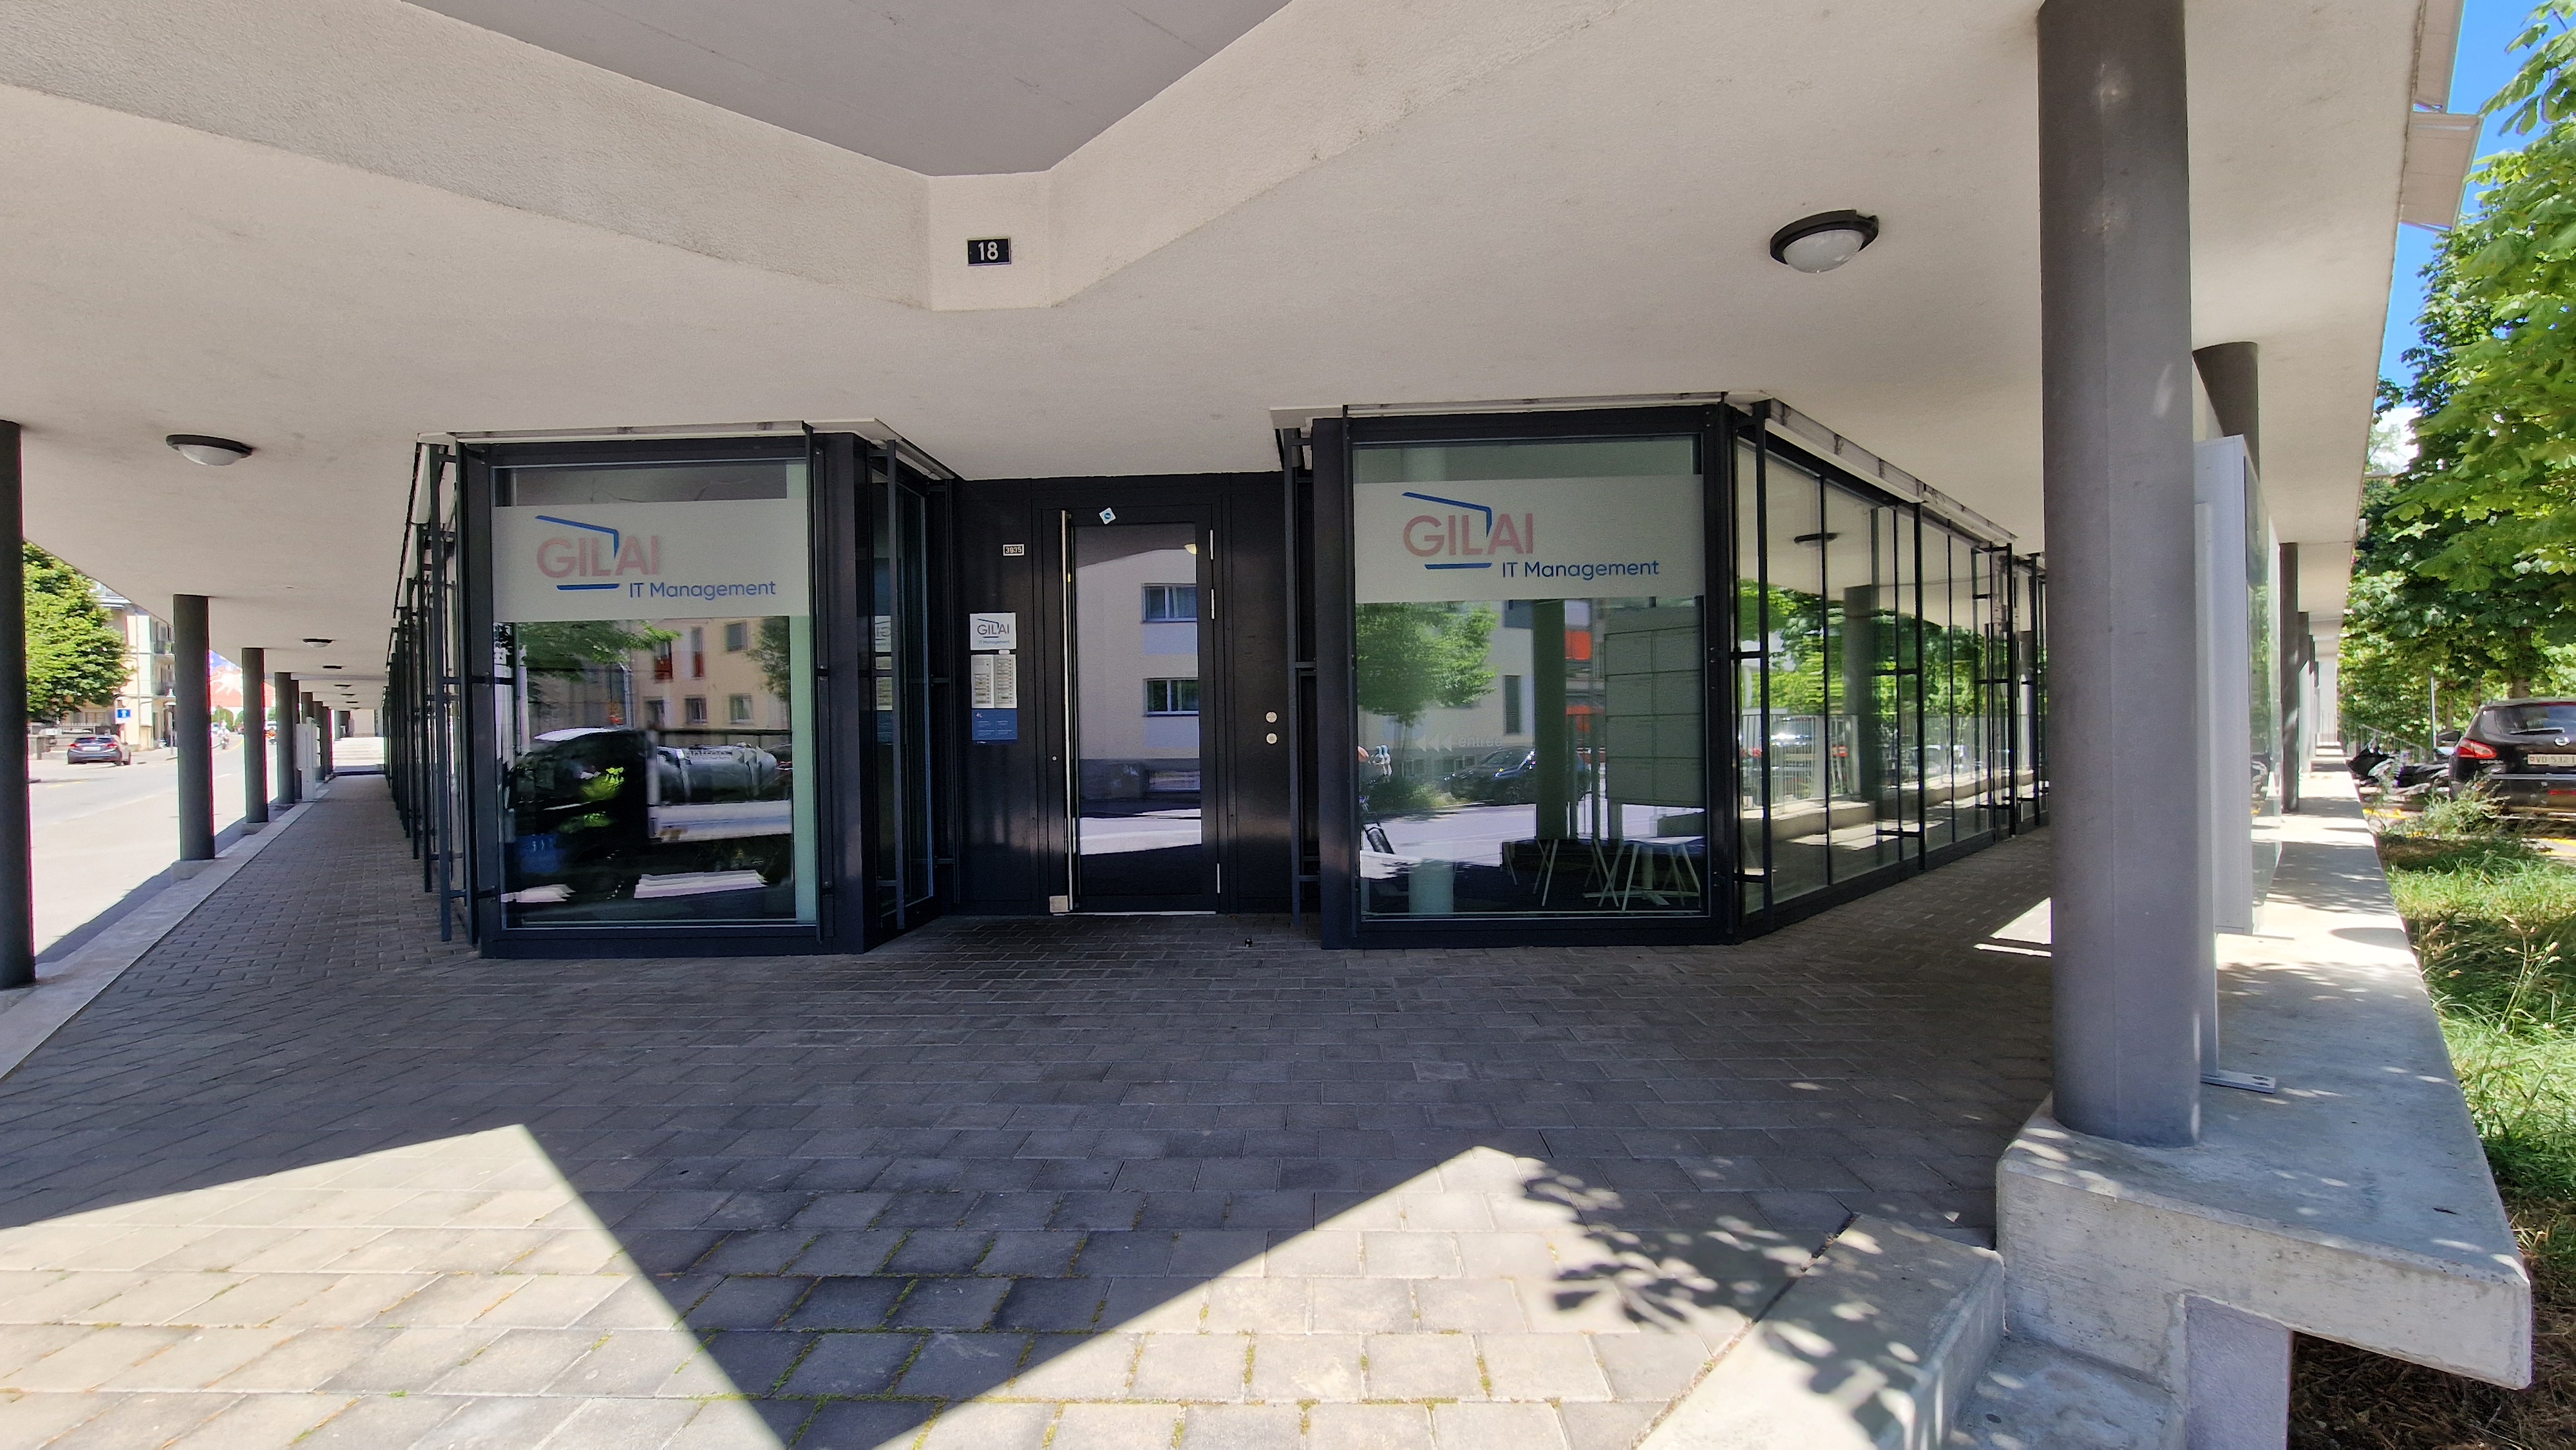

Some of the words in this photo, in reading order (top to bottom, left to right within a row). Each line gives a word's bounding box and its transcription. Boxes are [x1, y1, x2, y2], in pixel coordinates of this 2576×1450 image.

[978, 241, 998, 261] 18
[1403, 513, 1533, 557] GILAI
[536, 535, 659, 578] GILAI
[1502, 562, 1518, 578] IT
[1524, 560, 1660, 580] Management
[629, 582, 644, 598] IT
[650, 581, 776, 600] Management
[977, 623, 1010, 635] GILAI
